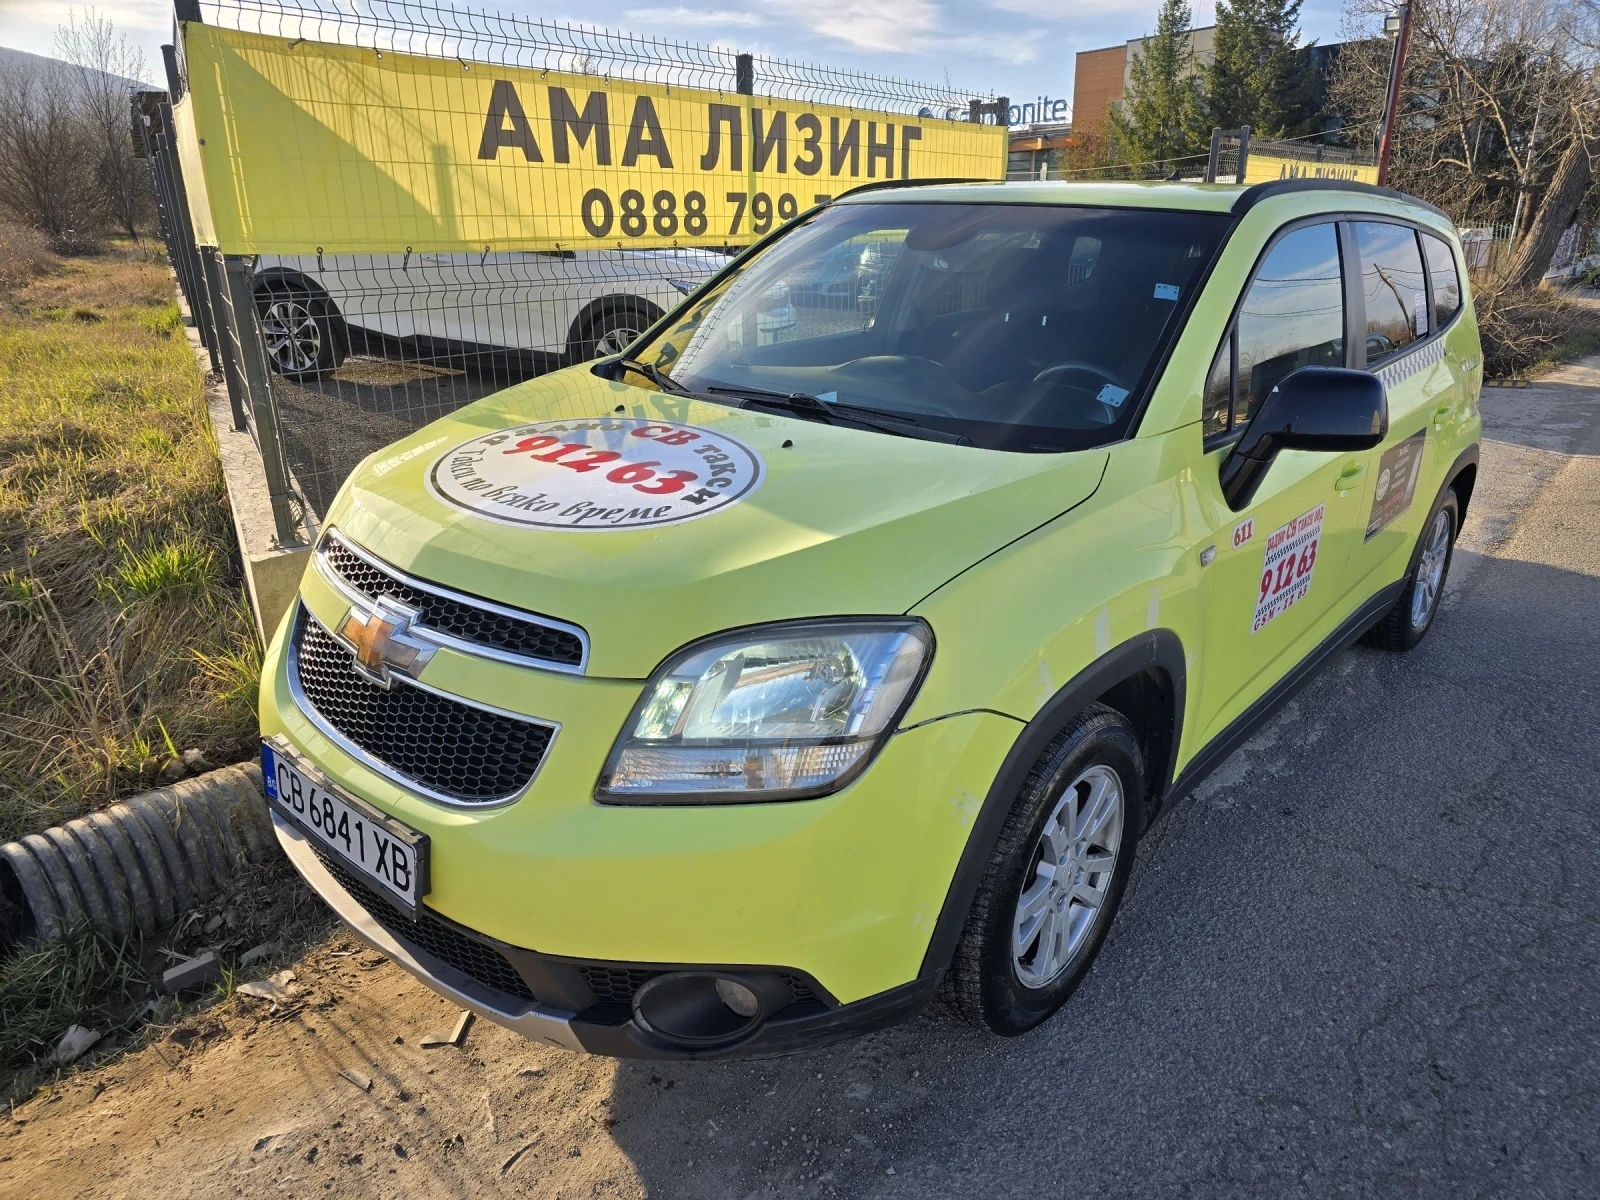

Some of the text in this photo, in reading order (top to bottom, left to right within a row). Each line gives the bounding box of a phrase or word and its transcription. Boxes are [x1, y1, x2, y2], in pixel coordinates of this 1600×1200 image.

[477, 79, 922, 181] АМА ЛИЗИНГ
[581, 187, 798, 238] 0888 799
[630, 425, 701, 446] СВ
[606, 461, 699, 495] 63
[460, 477, 494, 491] по
[558, 500, 672, 524] време
[1233, 520, 1253, 547] 611
[1253, 605, 1275, 631] GSM
[267, 777, 277, 790] BG
[309, 787, 366, 863] 6841
